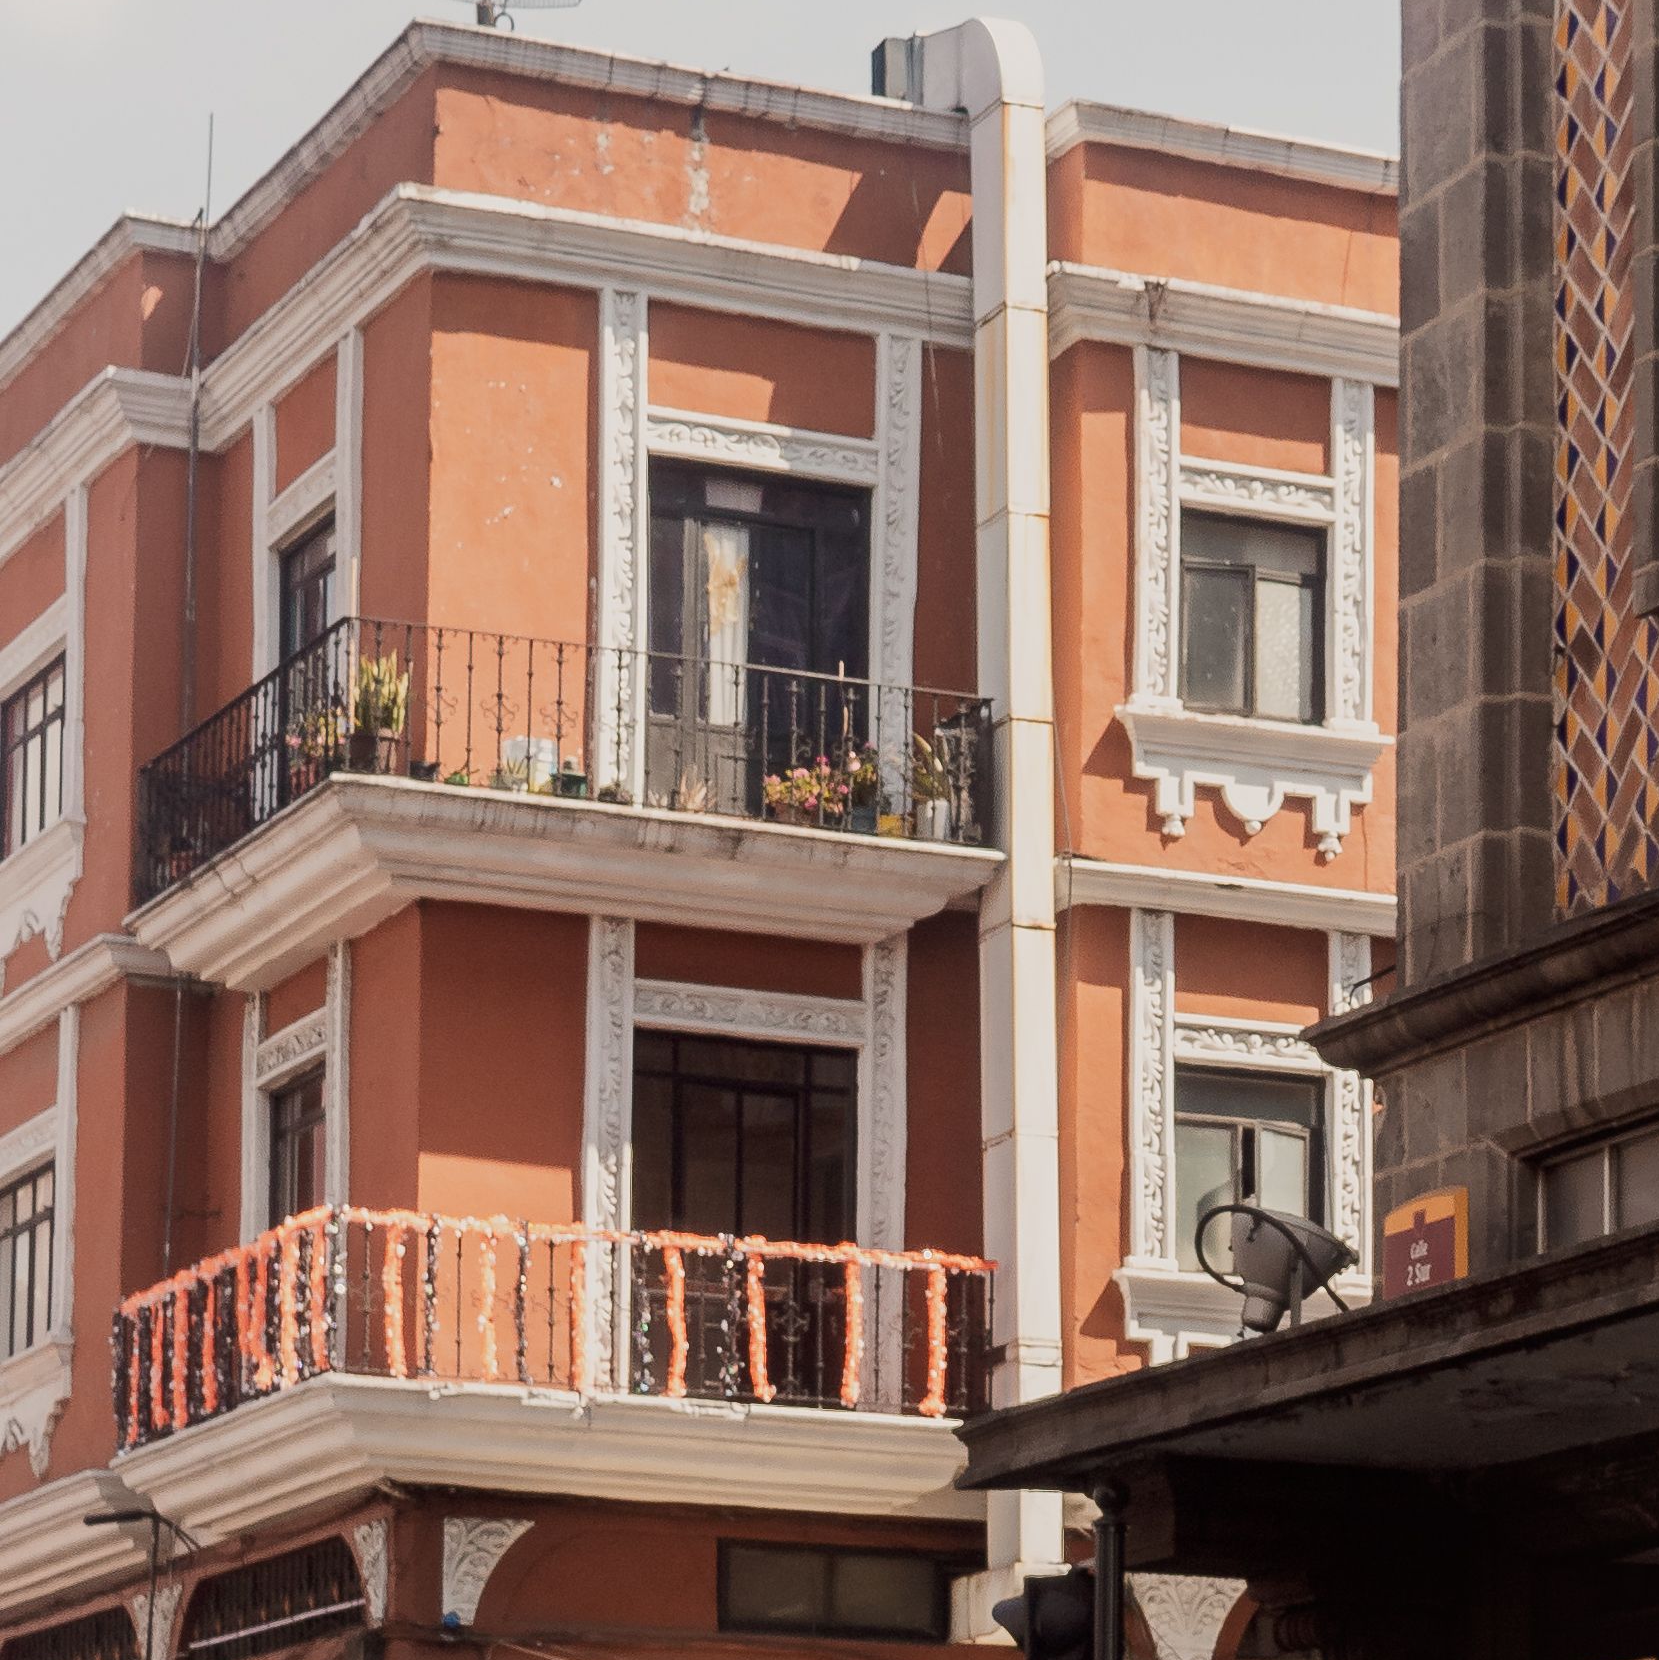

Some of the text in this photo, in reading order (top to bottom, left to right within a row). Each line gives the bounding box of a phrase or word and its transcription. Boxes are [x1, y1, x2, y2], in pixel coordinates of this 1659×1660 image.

[1410, 1239, 1429, 1260] Calle
[1406, 1263, 1432, 1287] 2 Sur
